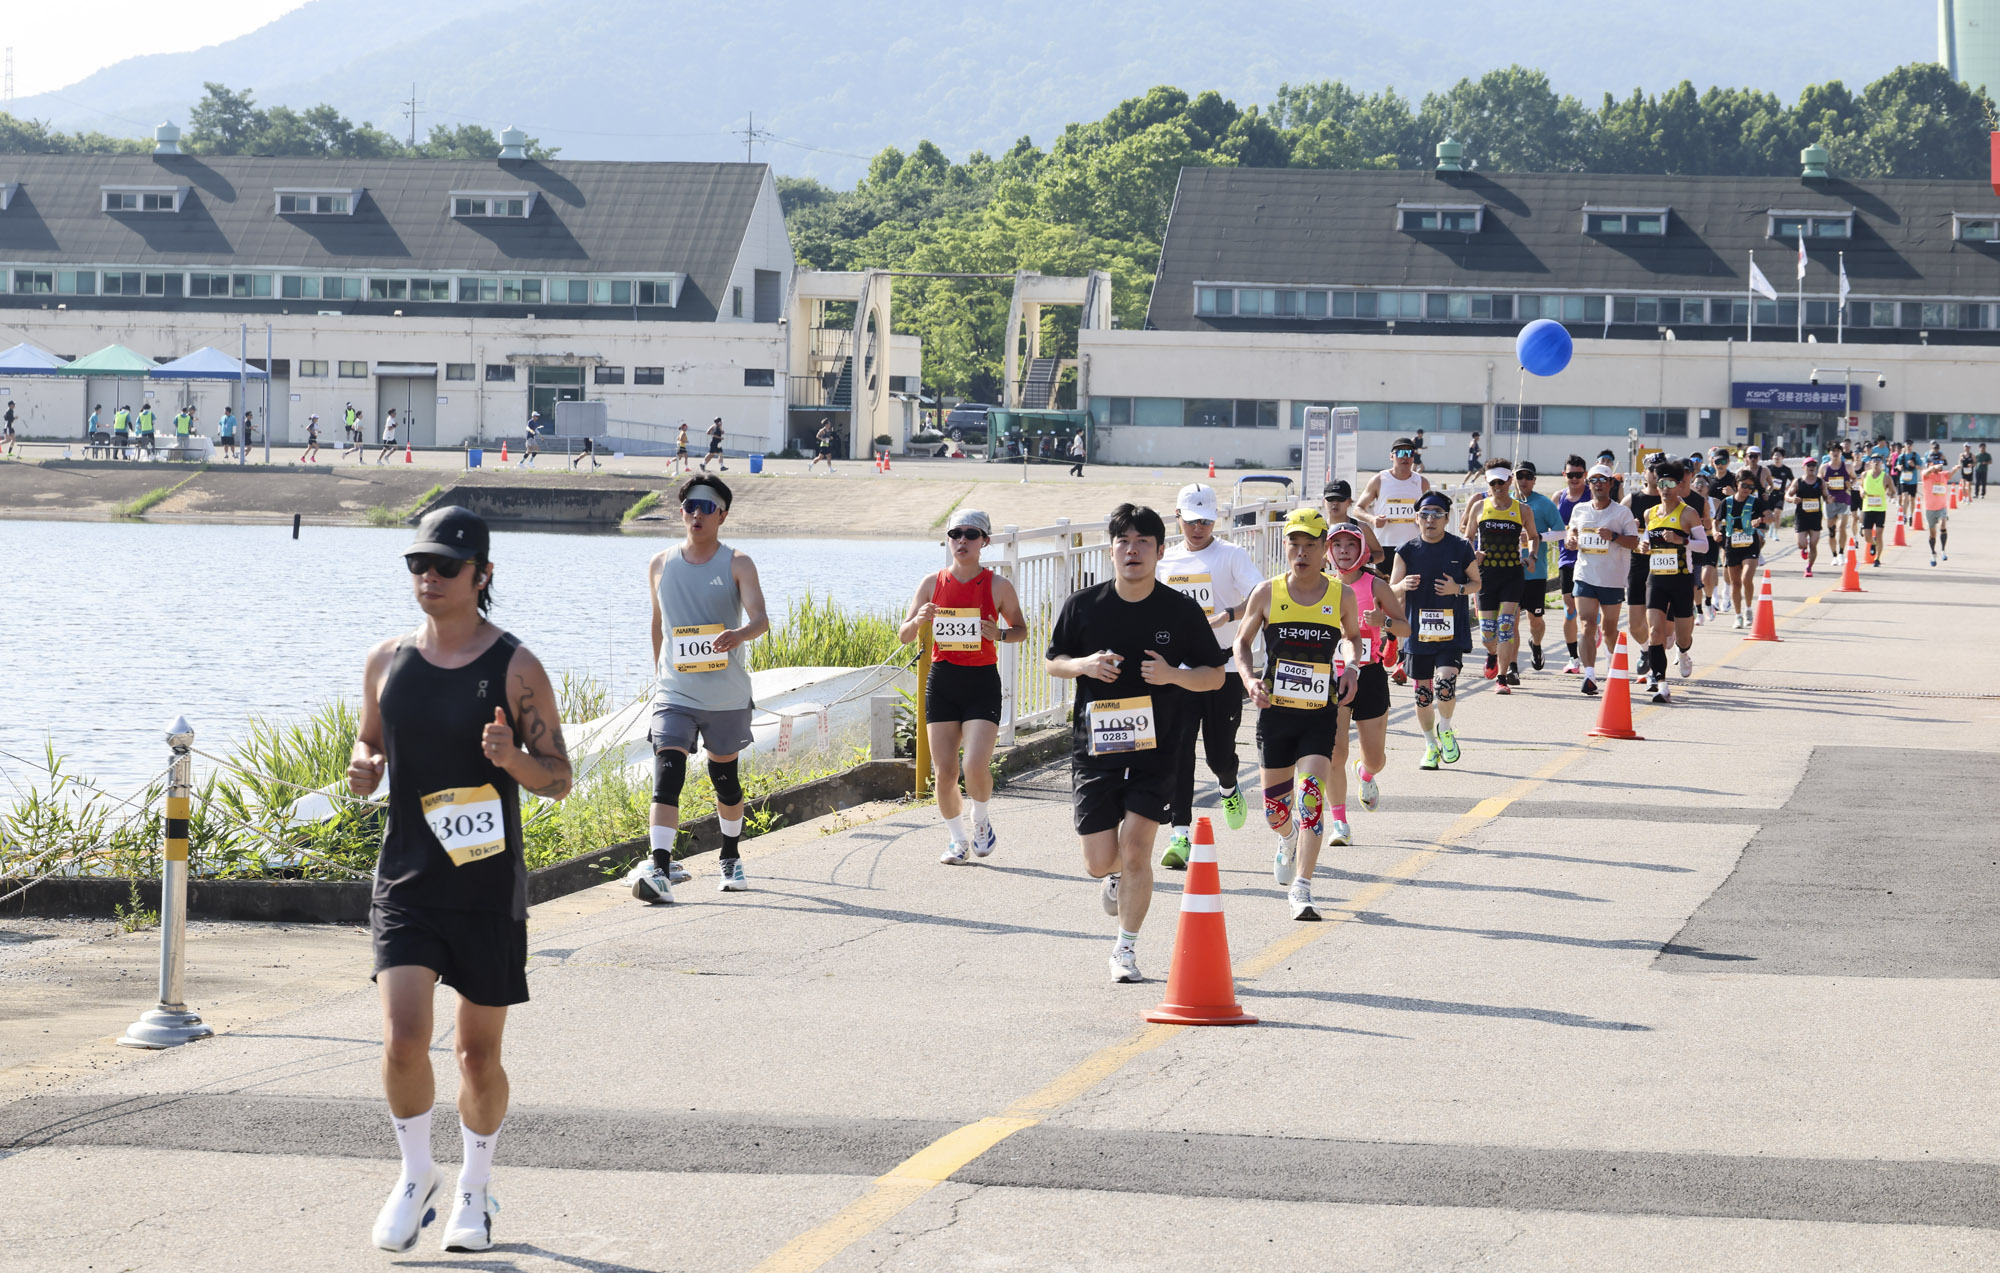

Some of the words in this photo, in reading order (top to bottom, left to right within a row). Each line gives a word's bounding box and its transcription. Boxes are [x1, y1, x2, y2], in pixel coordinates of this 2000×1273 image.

[1746, 390, 1771, 398] KSPO
[1389, 507, 1414, 515] 1170
[1652, 557, 1676, 566] 1305
[935, 622, 978, 637] 2334
[1278, 626, 1332, 641] 건국에이스
[679, 640, 719, 657] 106
[1284, 664, 1308, 677] 0405
[1098, 715, 1149, 732] 1089
[1102, 732, 1128, 742] 0283
[469, 848, 482, 858] 10
[483, 844, 500, 855] km
